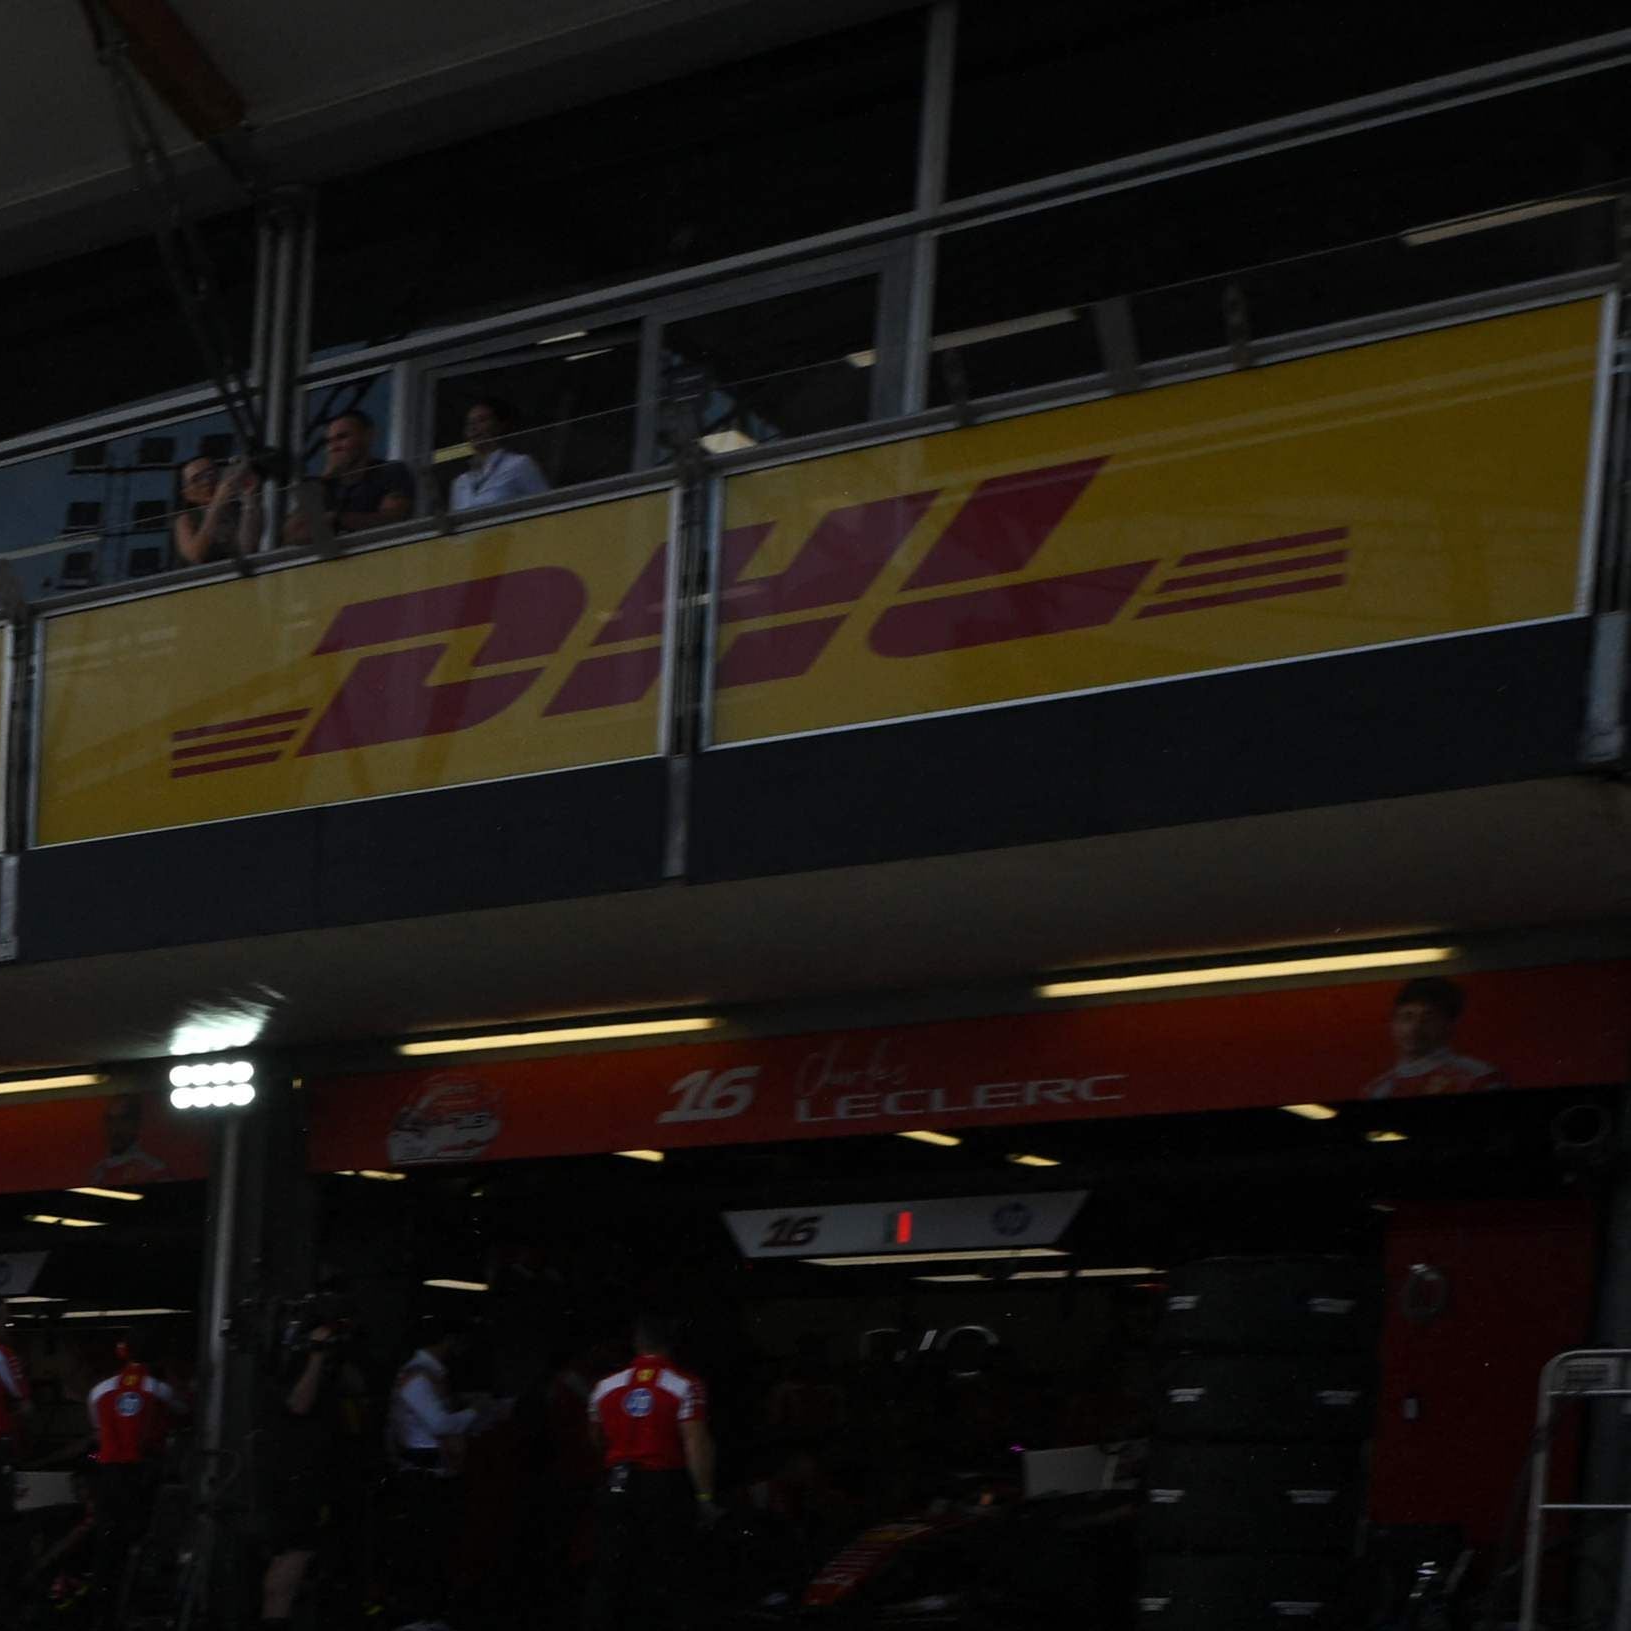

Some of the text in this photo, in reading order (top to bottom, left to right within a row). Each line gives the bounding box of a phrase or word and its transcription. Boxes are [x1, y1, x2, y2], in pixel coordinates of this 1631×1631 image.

[298, 456, 1161, 758] DHL
[656, 1066, 763, 1124] 16
[795, 1073, 1130, 1124] LECLERC
[760, 1213, 823, 1250] 16
